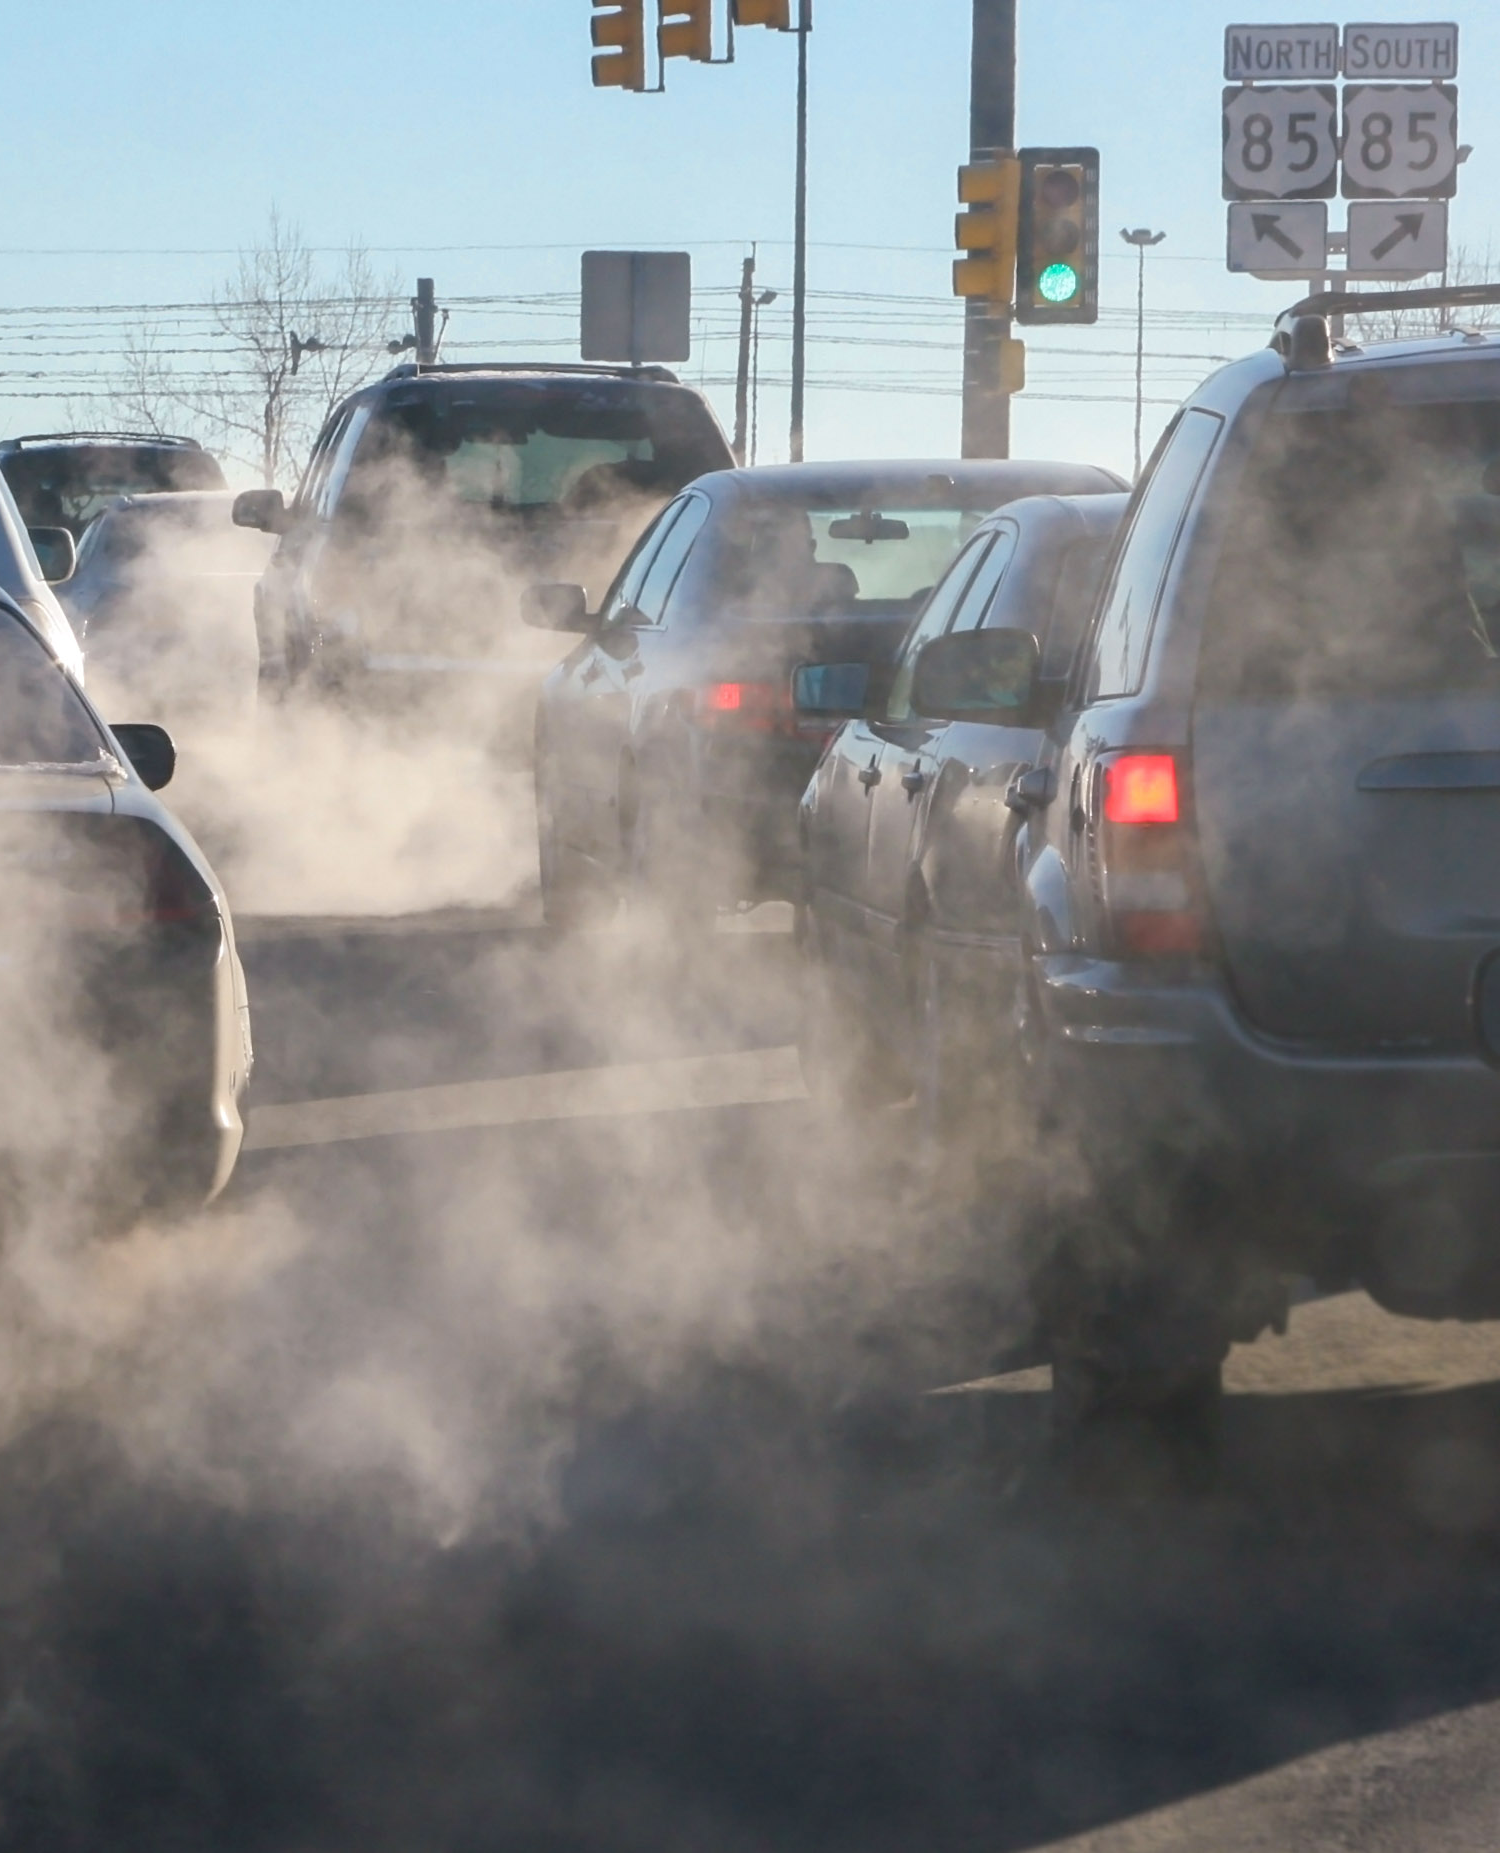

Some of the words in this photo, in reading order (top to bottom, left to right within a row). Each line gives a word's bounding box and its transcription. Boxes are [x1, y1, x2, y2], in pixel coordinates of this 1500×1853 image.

[1231, 36, 1331, 70] NORTH
[1350, 34, 1450, 69] SOUTH
[1241, 113, 1318, 172] 85
[1360, 112, 1437, 171] 85
